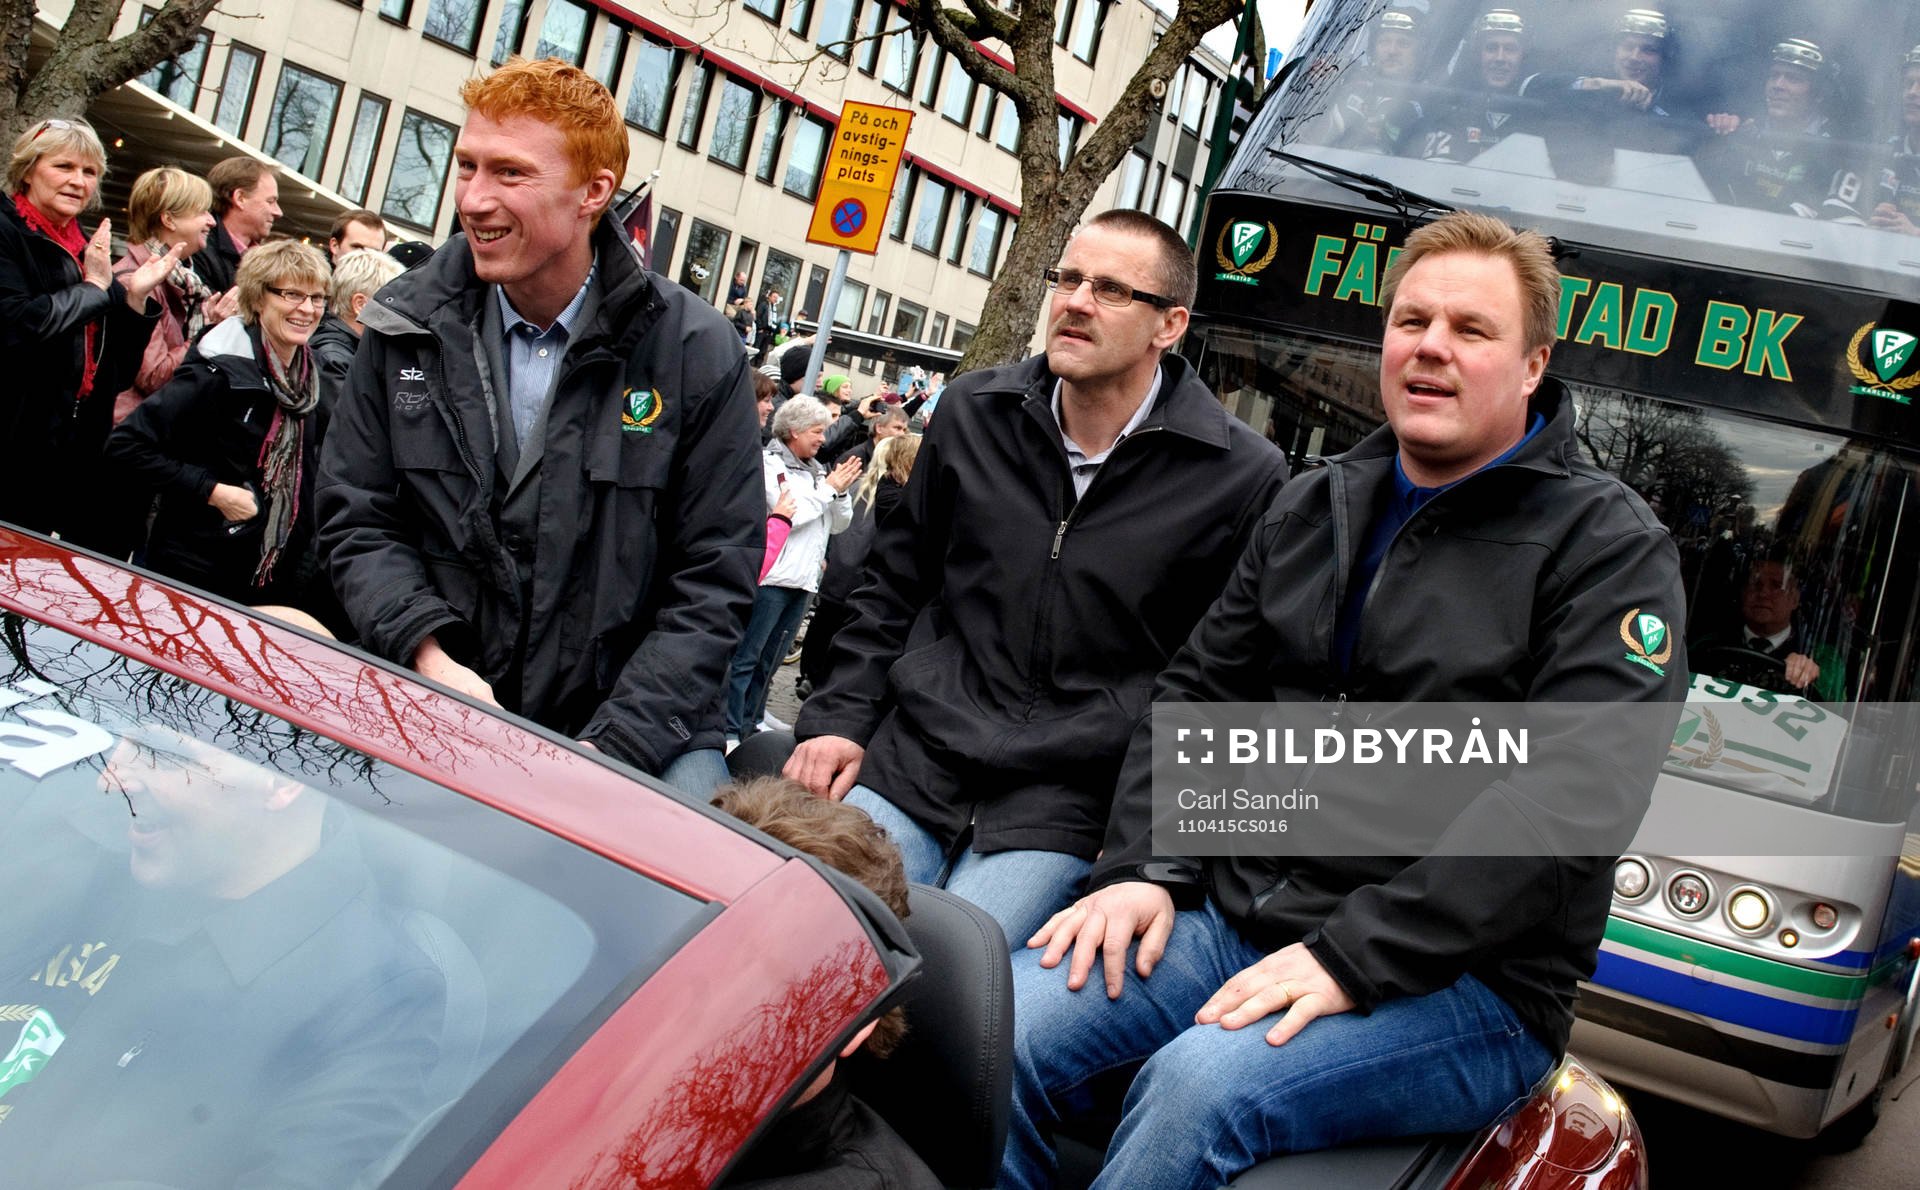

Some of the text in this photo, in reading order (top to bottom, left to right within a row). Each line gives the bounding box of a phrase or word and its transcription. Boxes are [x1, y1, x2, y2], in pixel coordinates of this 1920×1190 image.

[850, 110, 899, 131] På och
[843, 130, 896, 150] avstig-
[840, 147, 888, 166] nings-
[838, 165, 876, 183] plats
[1695, 300, 1805, 382] BK
[1861, 386, 1902, 401] KARLSTAD
